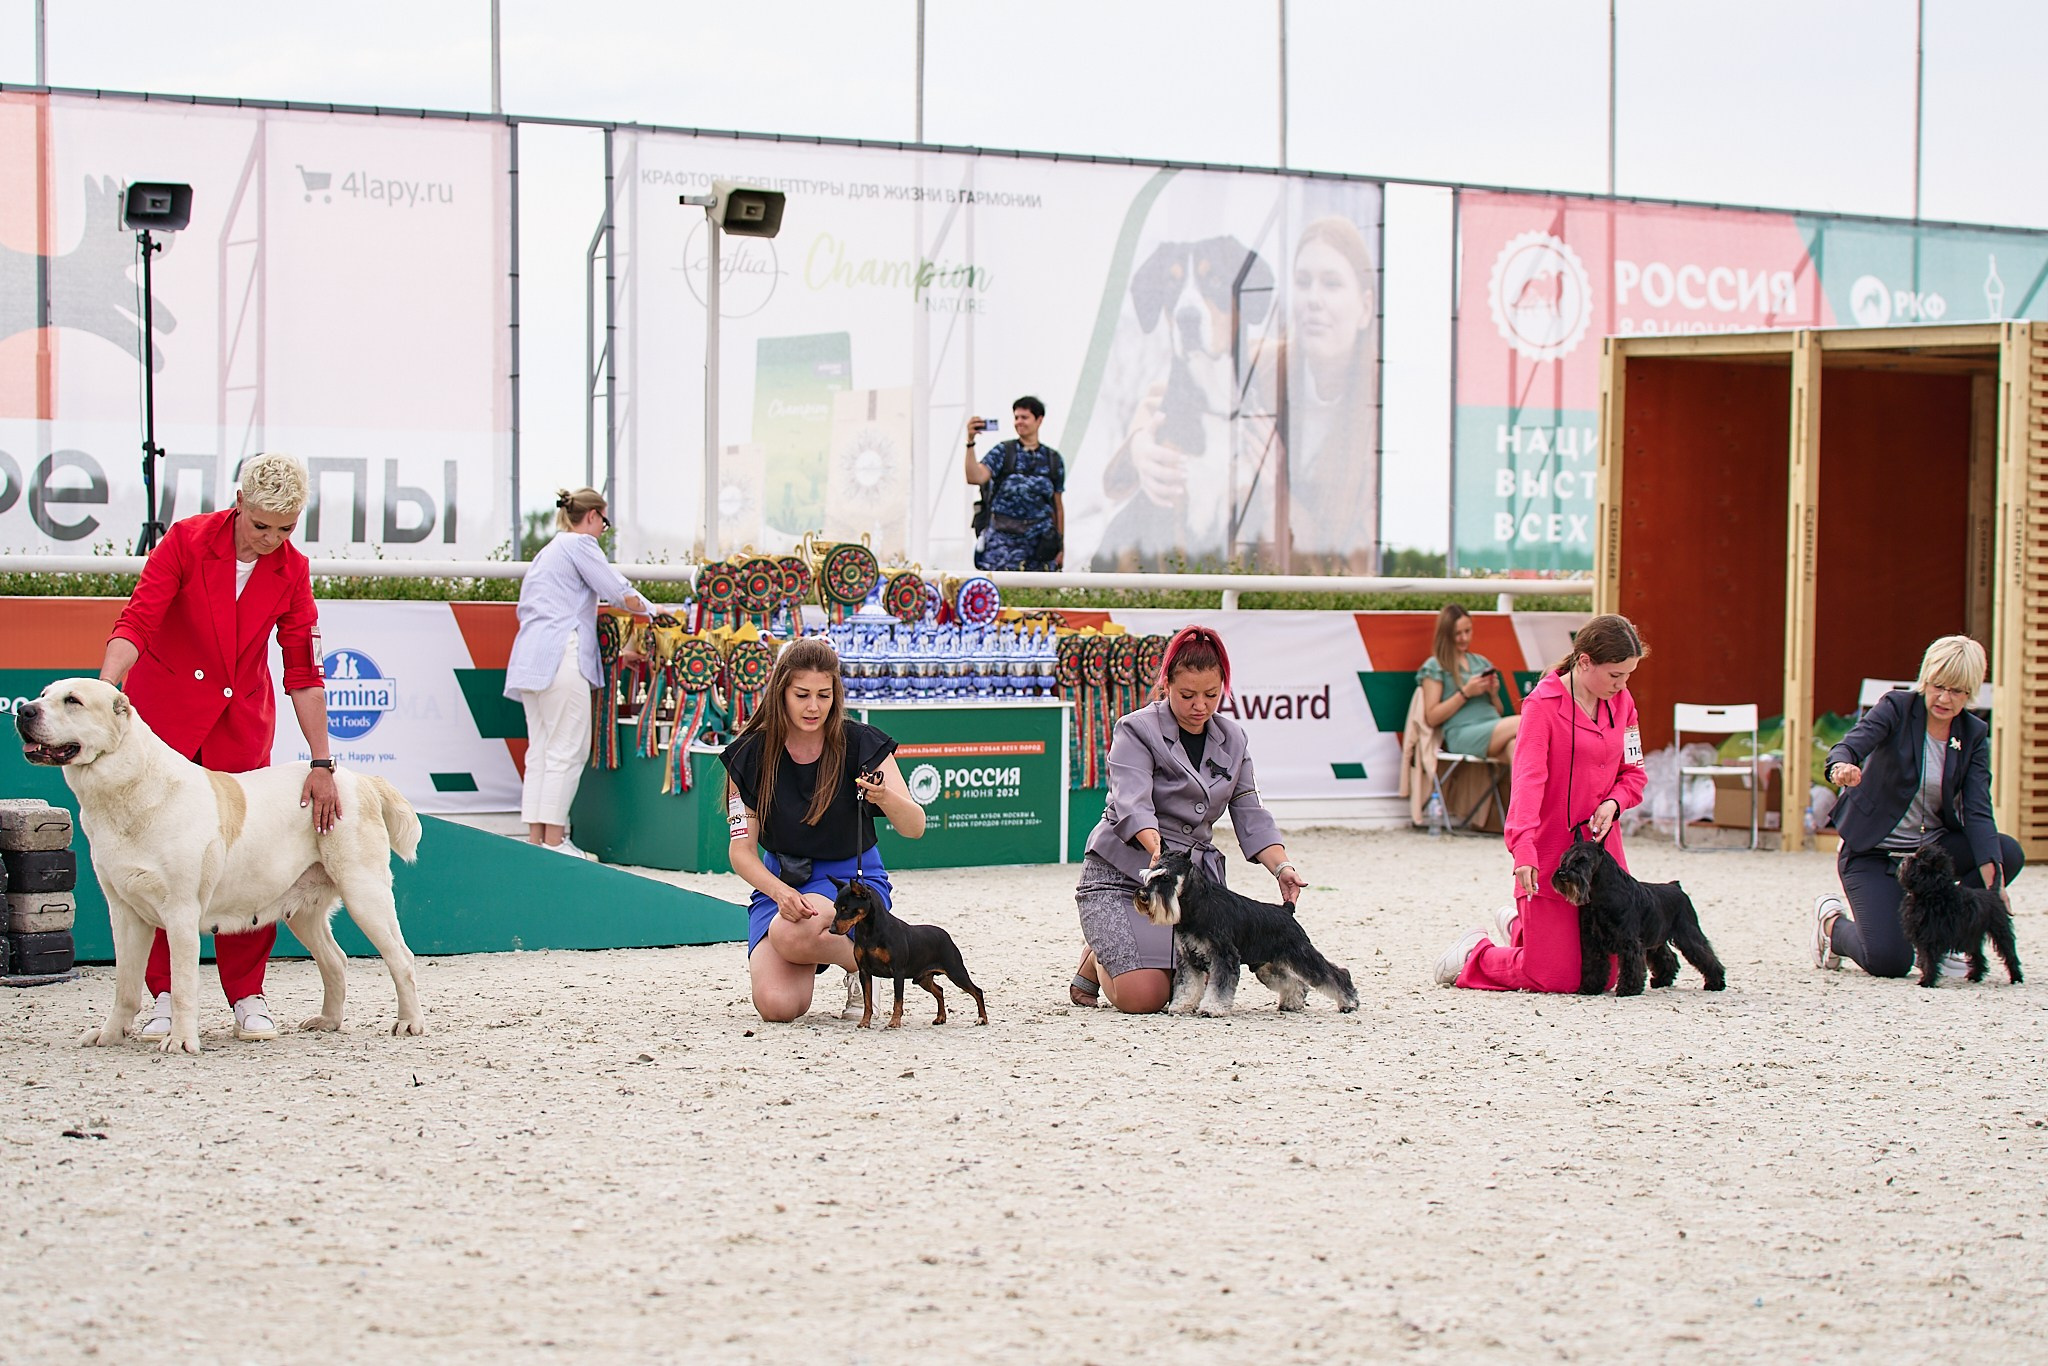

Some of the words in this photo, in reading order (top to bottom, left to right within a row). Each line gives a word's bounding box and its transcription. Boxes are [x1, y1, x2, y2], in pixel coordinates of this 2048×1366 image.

[341, 171, 453, 208] 4lapy.ru
[849, 183, 880, 200] ДЛЯ
[884, 185, 942, 202] ЖИЗНИ
[946, 188, 956, 203] В
[959, 189, 1042, 208] ГАРМОНИИ
[804, 232, 993, 304] Champion
[1614, 259, 1797, 315] РОССИЯ
[925, 296, 987, 314] NATURE
[1895, 290, 1946, 320] РКФ
[158, 454, 457, 543] лпы
[1496, 467, 1598, 500] ВЫСТ
[1494, 511, 1589, 544] ВСЕХ
[1218, 684, 1330, 720] Award
[342, 715, 371, 727] Foods
[348, 752, 376, 763] Happy
[379, 754, 397, 763] you.
[944, 767, 1021, 788] РОССИЯ
[944, 790, 961, 799] 8-9
[963, 788, 993, 798] ИЮНЯ
[996, 788, 1019, 798] 2024
